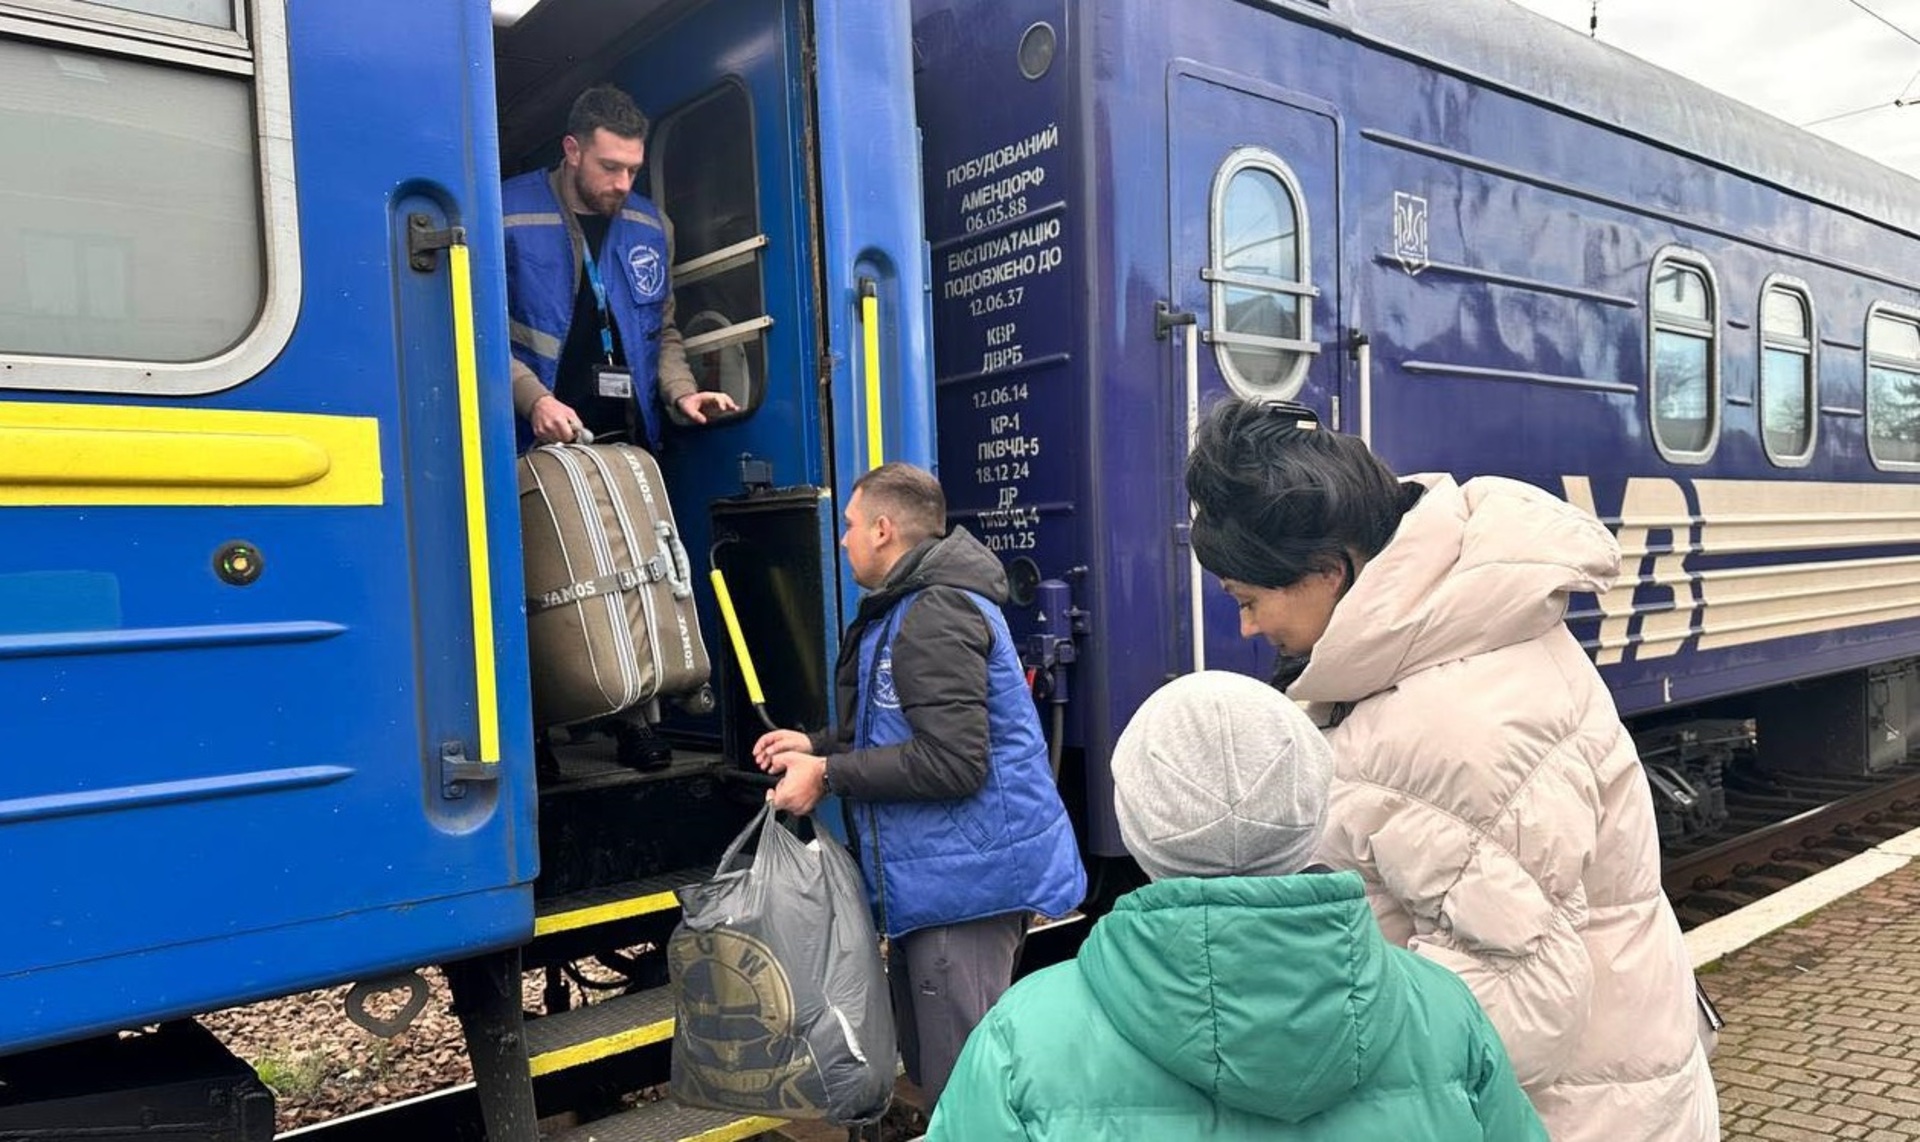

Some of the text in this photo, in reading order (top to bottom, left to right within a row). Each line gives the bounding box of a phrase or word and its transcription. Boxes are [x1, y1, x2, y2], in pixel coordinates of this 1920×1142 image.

[946, 122, 1059, 188] ПОБУДОВАНИЙ
[960, 165, 1045, 214] АМЕНДОРФ
[966, 196, 1027, 233] 06.05.88
[948, 217, 1061, 272] ЕКСПЛУАТАЦІЮ
[944, 246, 1062, 299] ПОДОВЖЕНО ДО
[969, 286, 1025, 317] 12.06.37
[987, 323, 1016, 347] КВР
[981, 345, 1023, 374] ДВРБ
[973, 383, 1029, 409] 12.06.14
[991, 412, 1020, 435] КР-1
[978, 437, 1039, 461] ПКВЧД-5
[624, 451, 654, 504] JAMOS
[998, 486, 1018, 509] ДР
[984, 531, 1036, 551] 20.11.25
[540, 580, 597, 608] JAMOS
[677, 615, 695, 670] JAMOS
